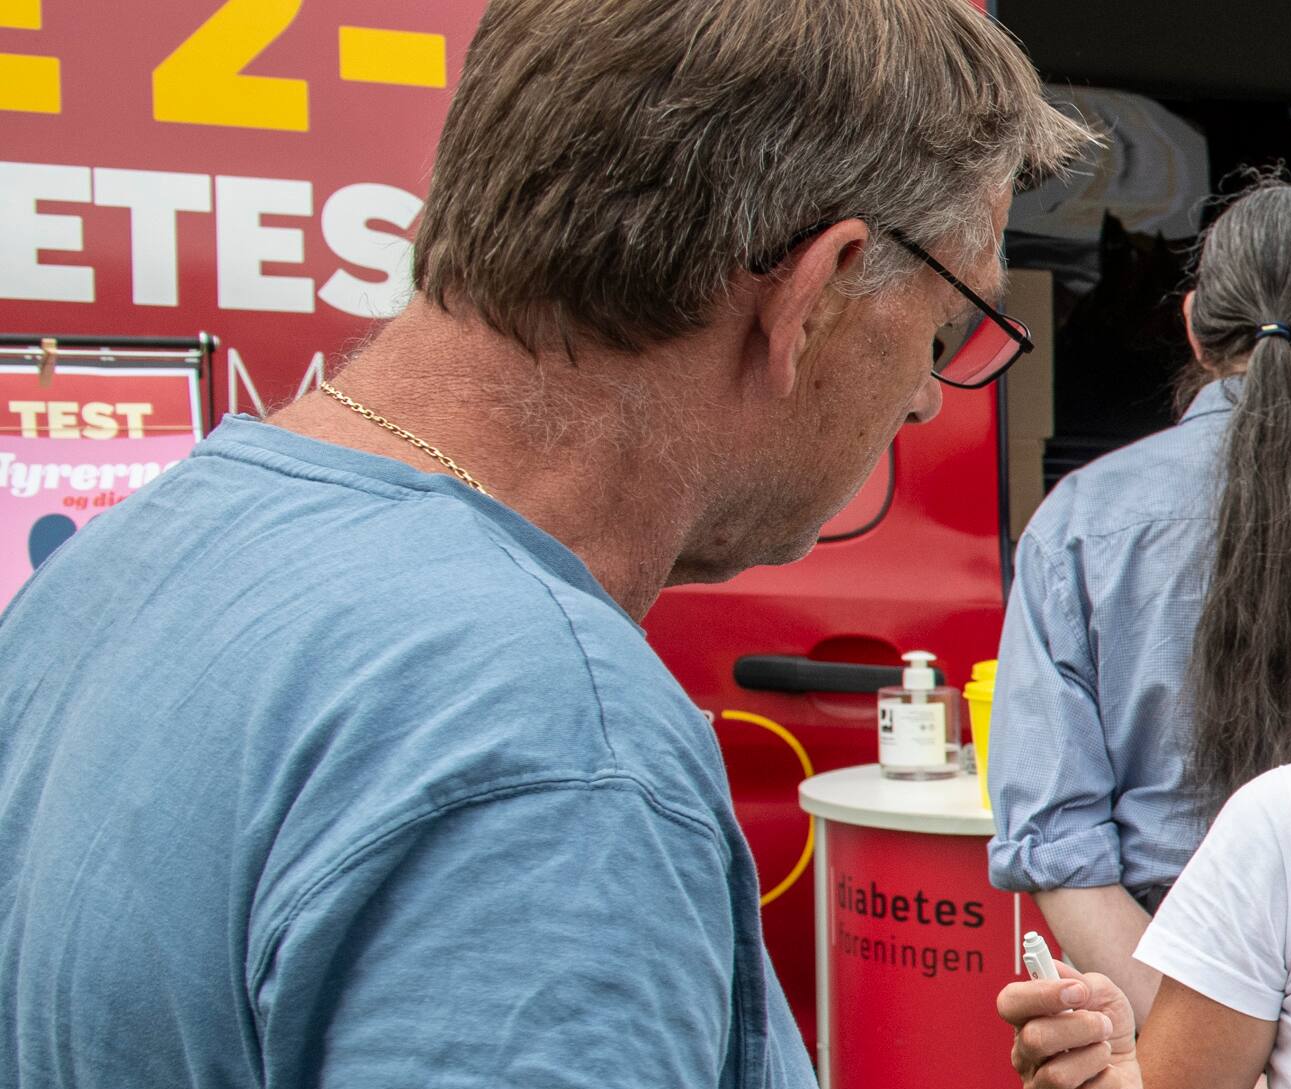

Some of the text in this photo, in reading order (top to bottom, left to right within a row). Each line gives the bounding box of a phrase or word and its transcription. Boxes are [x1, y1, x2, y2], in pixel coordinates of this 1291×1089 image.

[8, 400, 153, 440] TEST
[93, 492, 126, 508] di
[838, 873, 985, 929] diabetes
